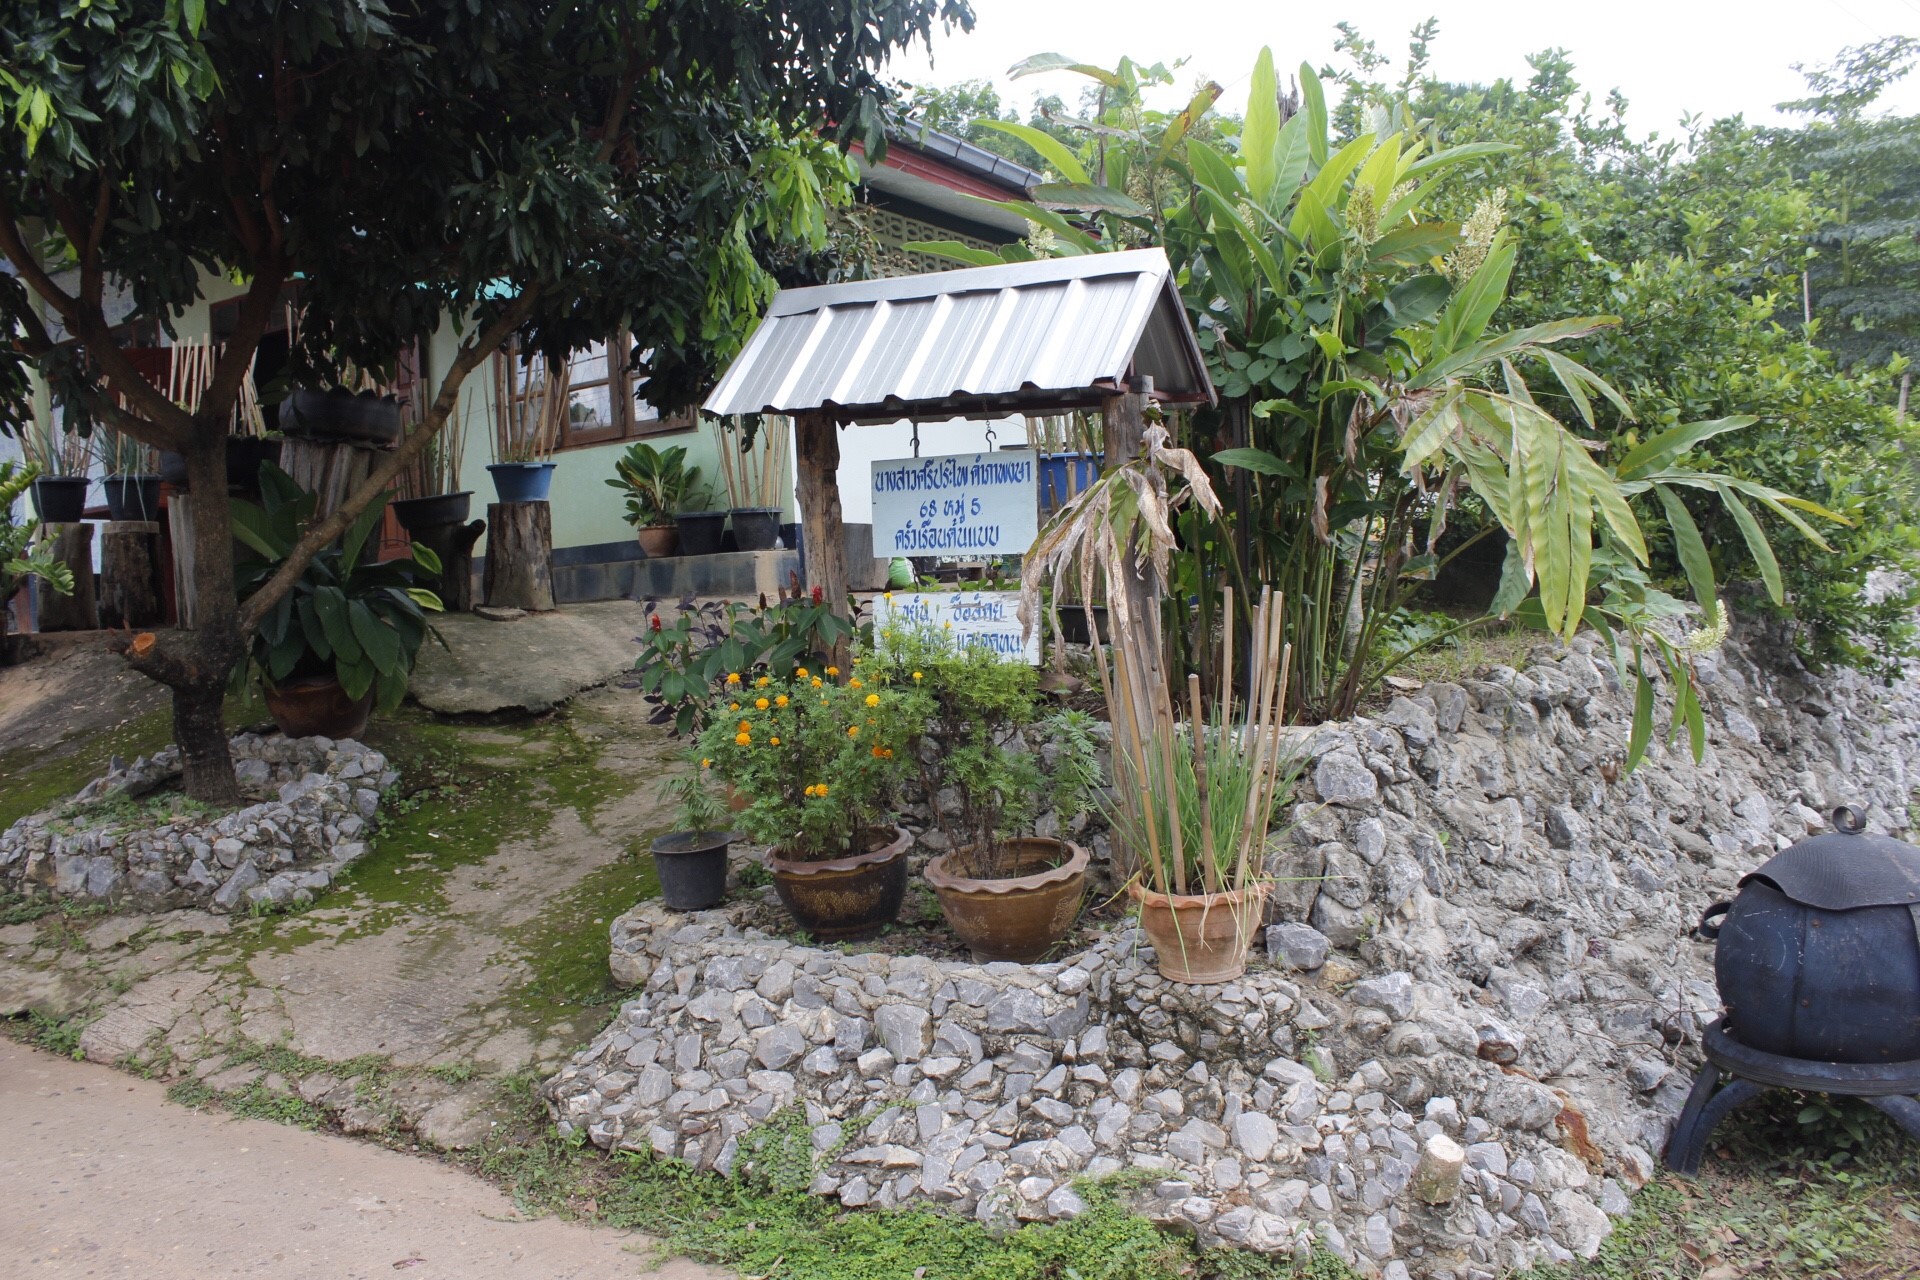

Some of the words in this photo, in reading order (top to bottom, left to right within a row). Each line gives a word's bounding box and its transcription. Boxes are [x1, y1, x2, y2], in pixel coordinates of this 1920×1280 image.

[919, 499, 938, 519] 68
[943, 492, 966, 524] หมู่
[970, 497, 981, 516] 5
[894, 518, 1000, 551] ครัวเรือนต้นแบบ
